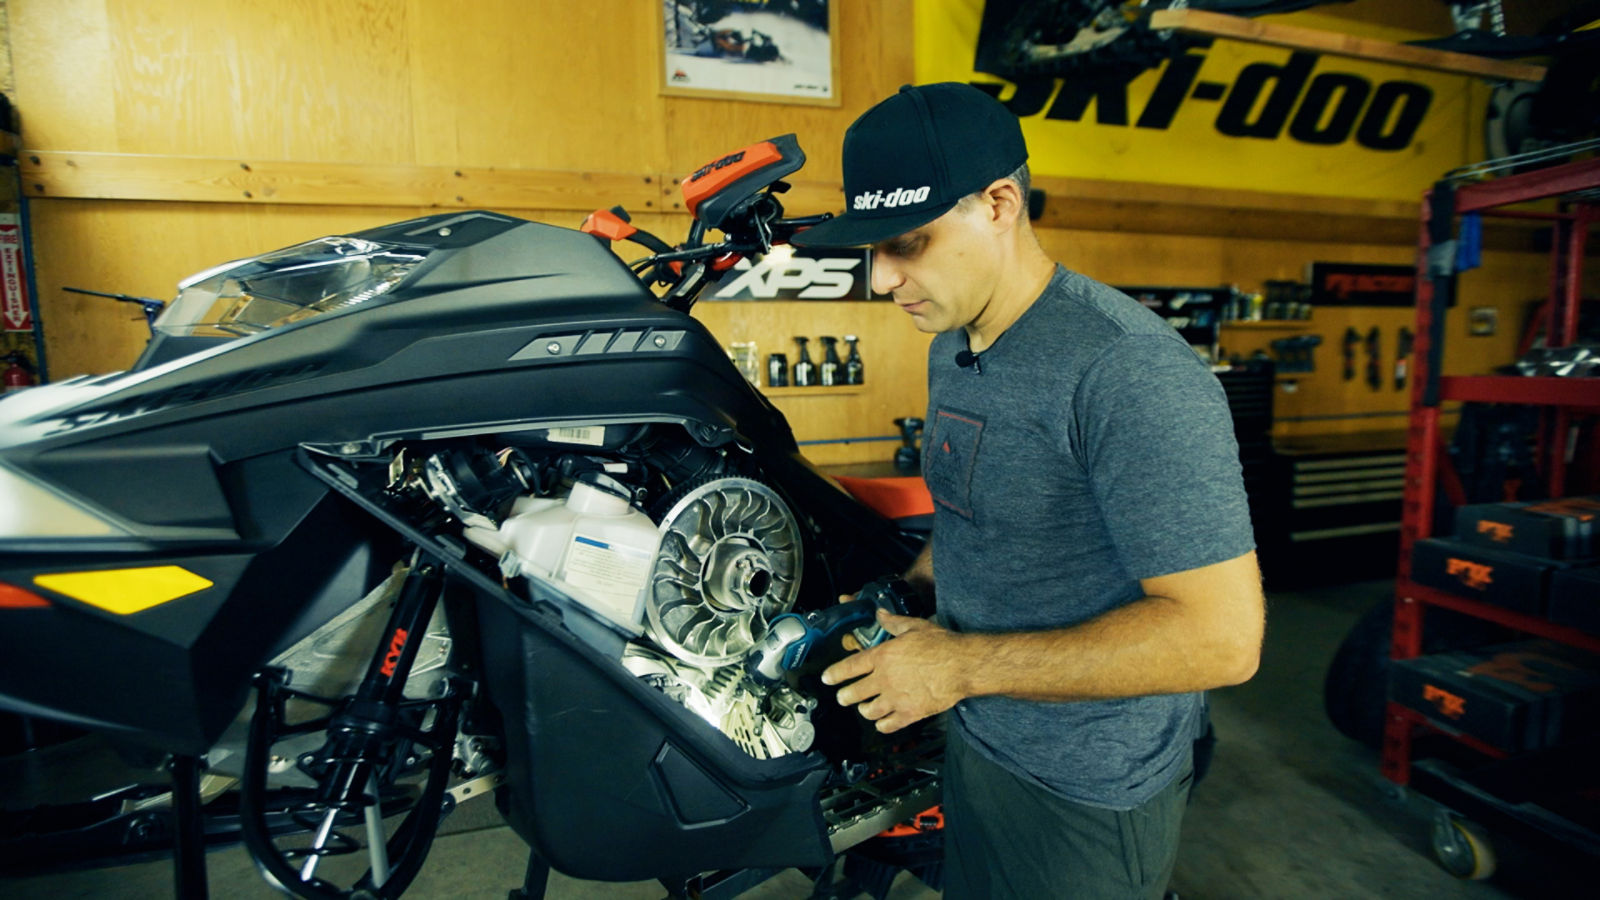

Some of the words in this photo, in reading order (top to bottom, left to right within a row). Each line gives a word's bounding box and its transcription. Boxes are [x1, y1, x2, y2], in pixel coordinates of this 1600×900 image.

[853, 186, 930, 210] ski-doo
[715, 257, 862, 298] XPS
[380, 628, 408, 677] KYB
